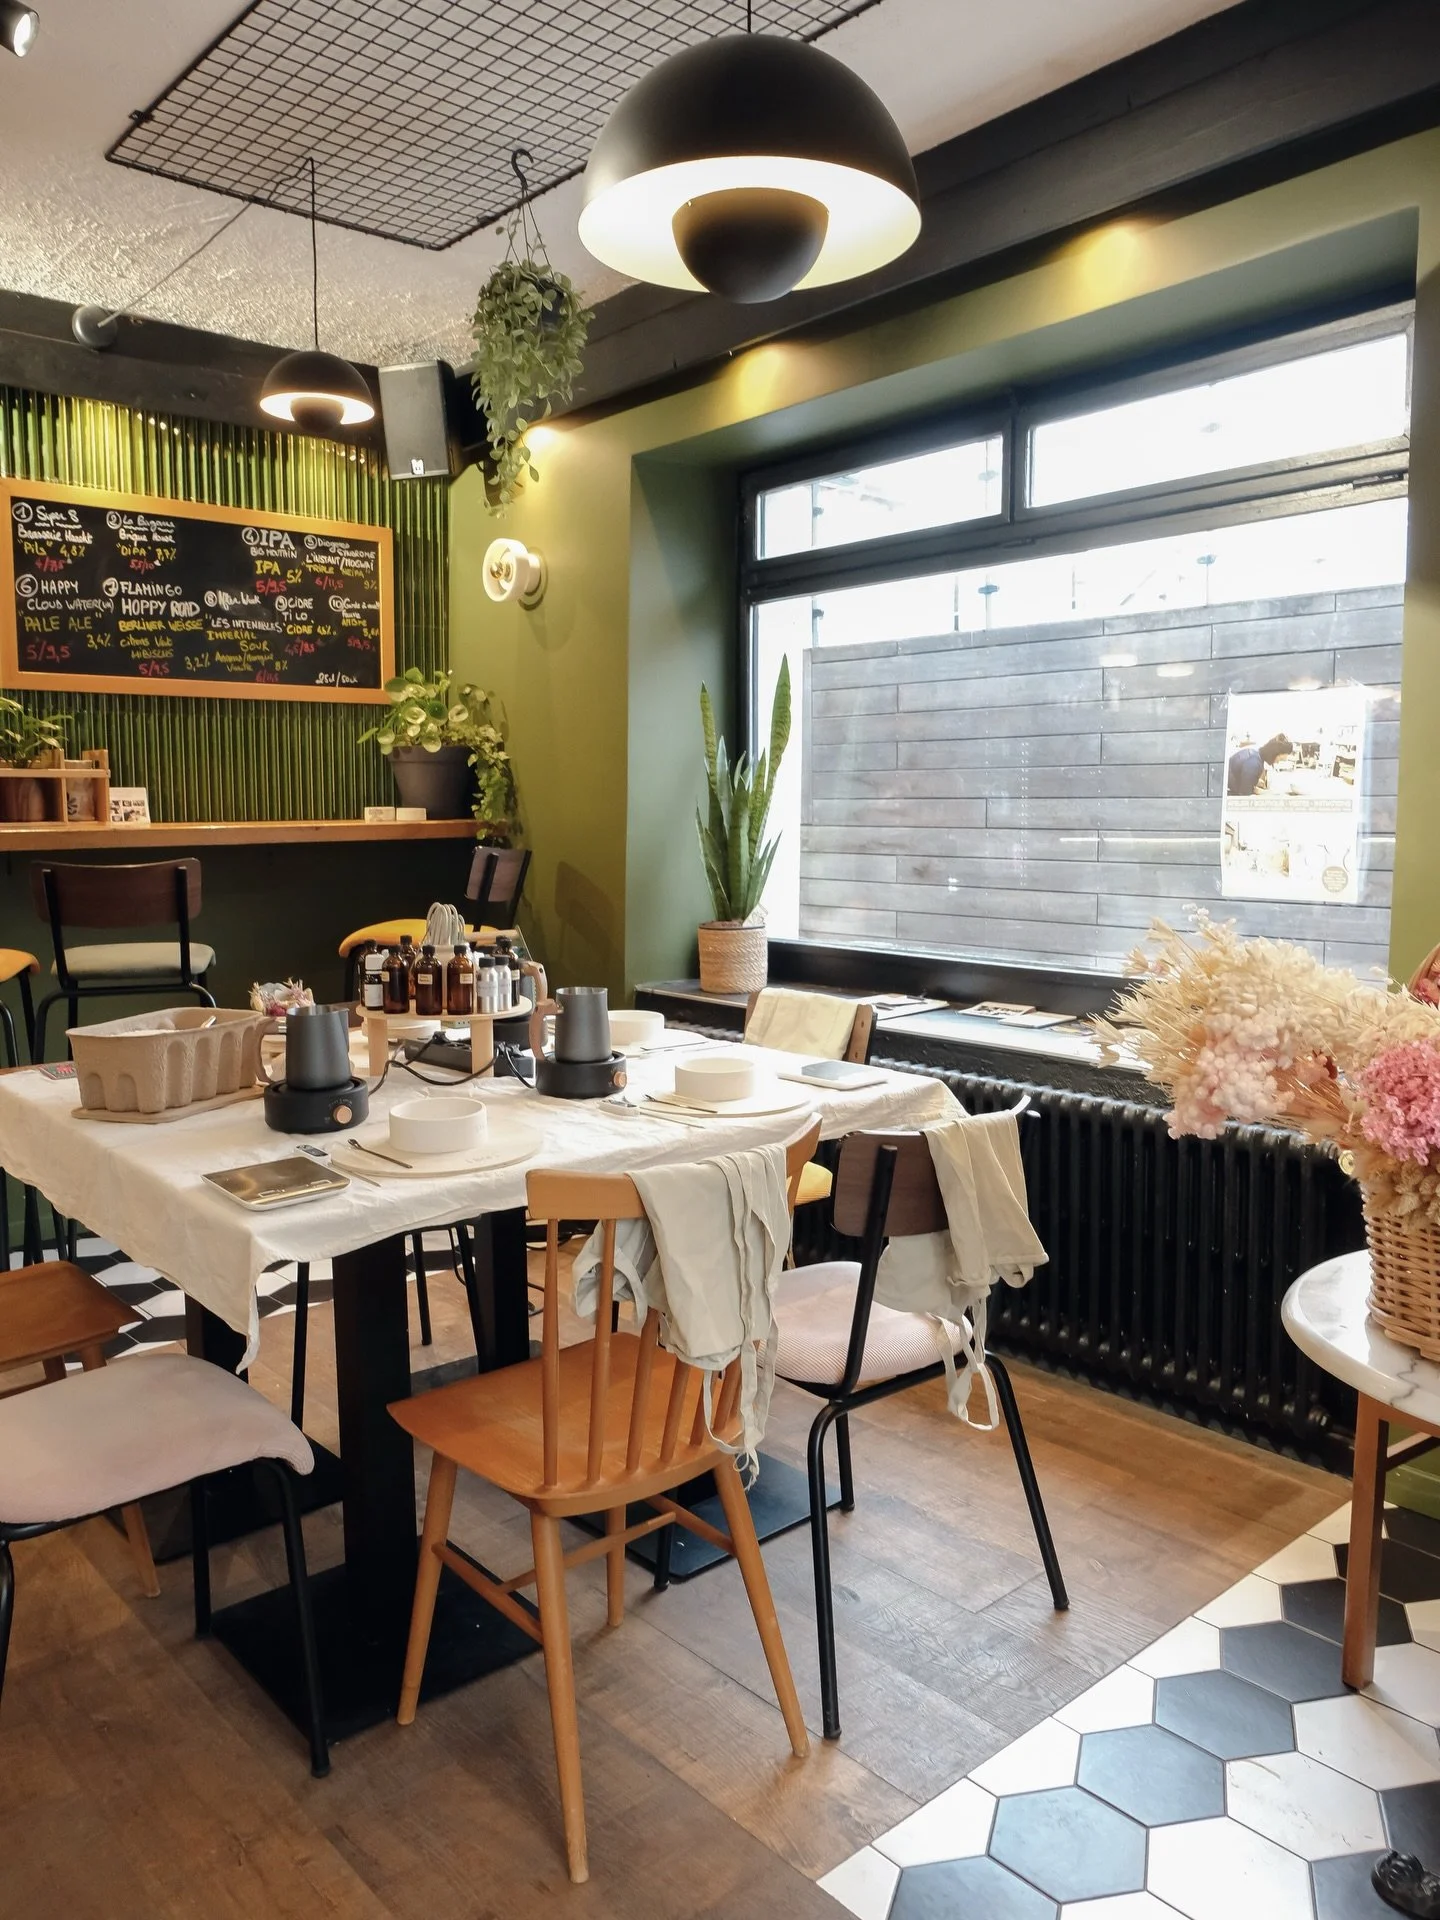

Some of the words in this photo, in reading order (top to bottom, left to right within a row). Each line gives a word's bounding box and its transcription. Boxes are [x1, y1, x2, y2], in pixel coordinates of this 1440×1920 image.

[68, 509, 79, 523] 8
[260, 529, 296, 550] IPA
[255, 559, 281, 575] IPA
[287, 569, 303, 584] 5%
[41, 579, 79, 595] HAPPY
[26, 598, 63, 610] CLOUD
[121, 597, 167, 616] HOPPY
[170, 600, 201, 618] ROAD
[27, 641, 71, 663] 5/9,5
[184, 651, 211, 672] 3,2%
